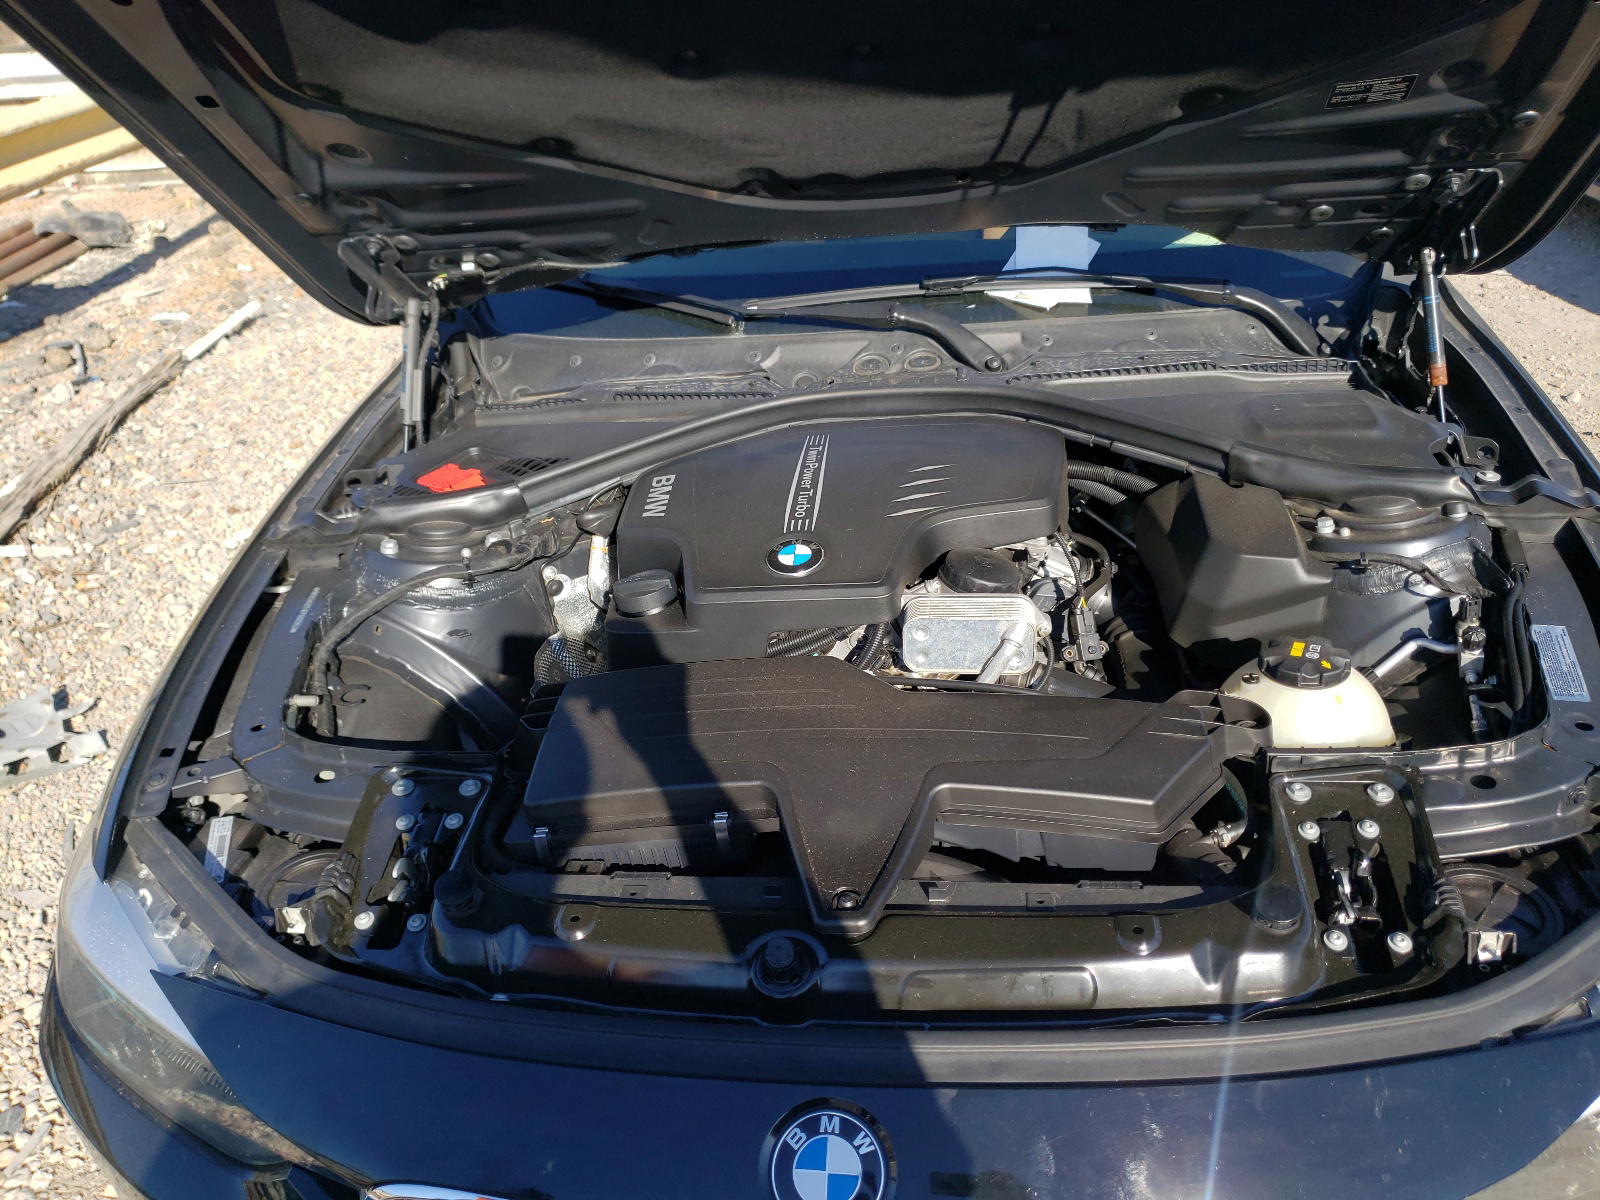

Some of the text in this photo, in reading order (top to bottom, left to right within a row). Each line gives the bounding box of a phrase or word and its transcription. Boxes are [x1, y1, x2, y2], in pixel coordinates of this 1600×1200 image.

[642, 474, 676, 517] BMW
[795, 445, 822, 518] TwinPower Turbo
[785, 1115, 876, 1155] BMW
